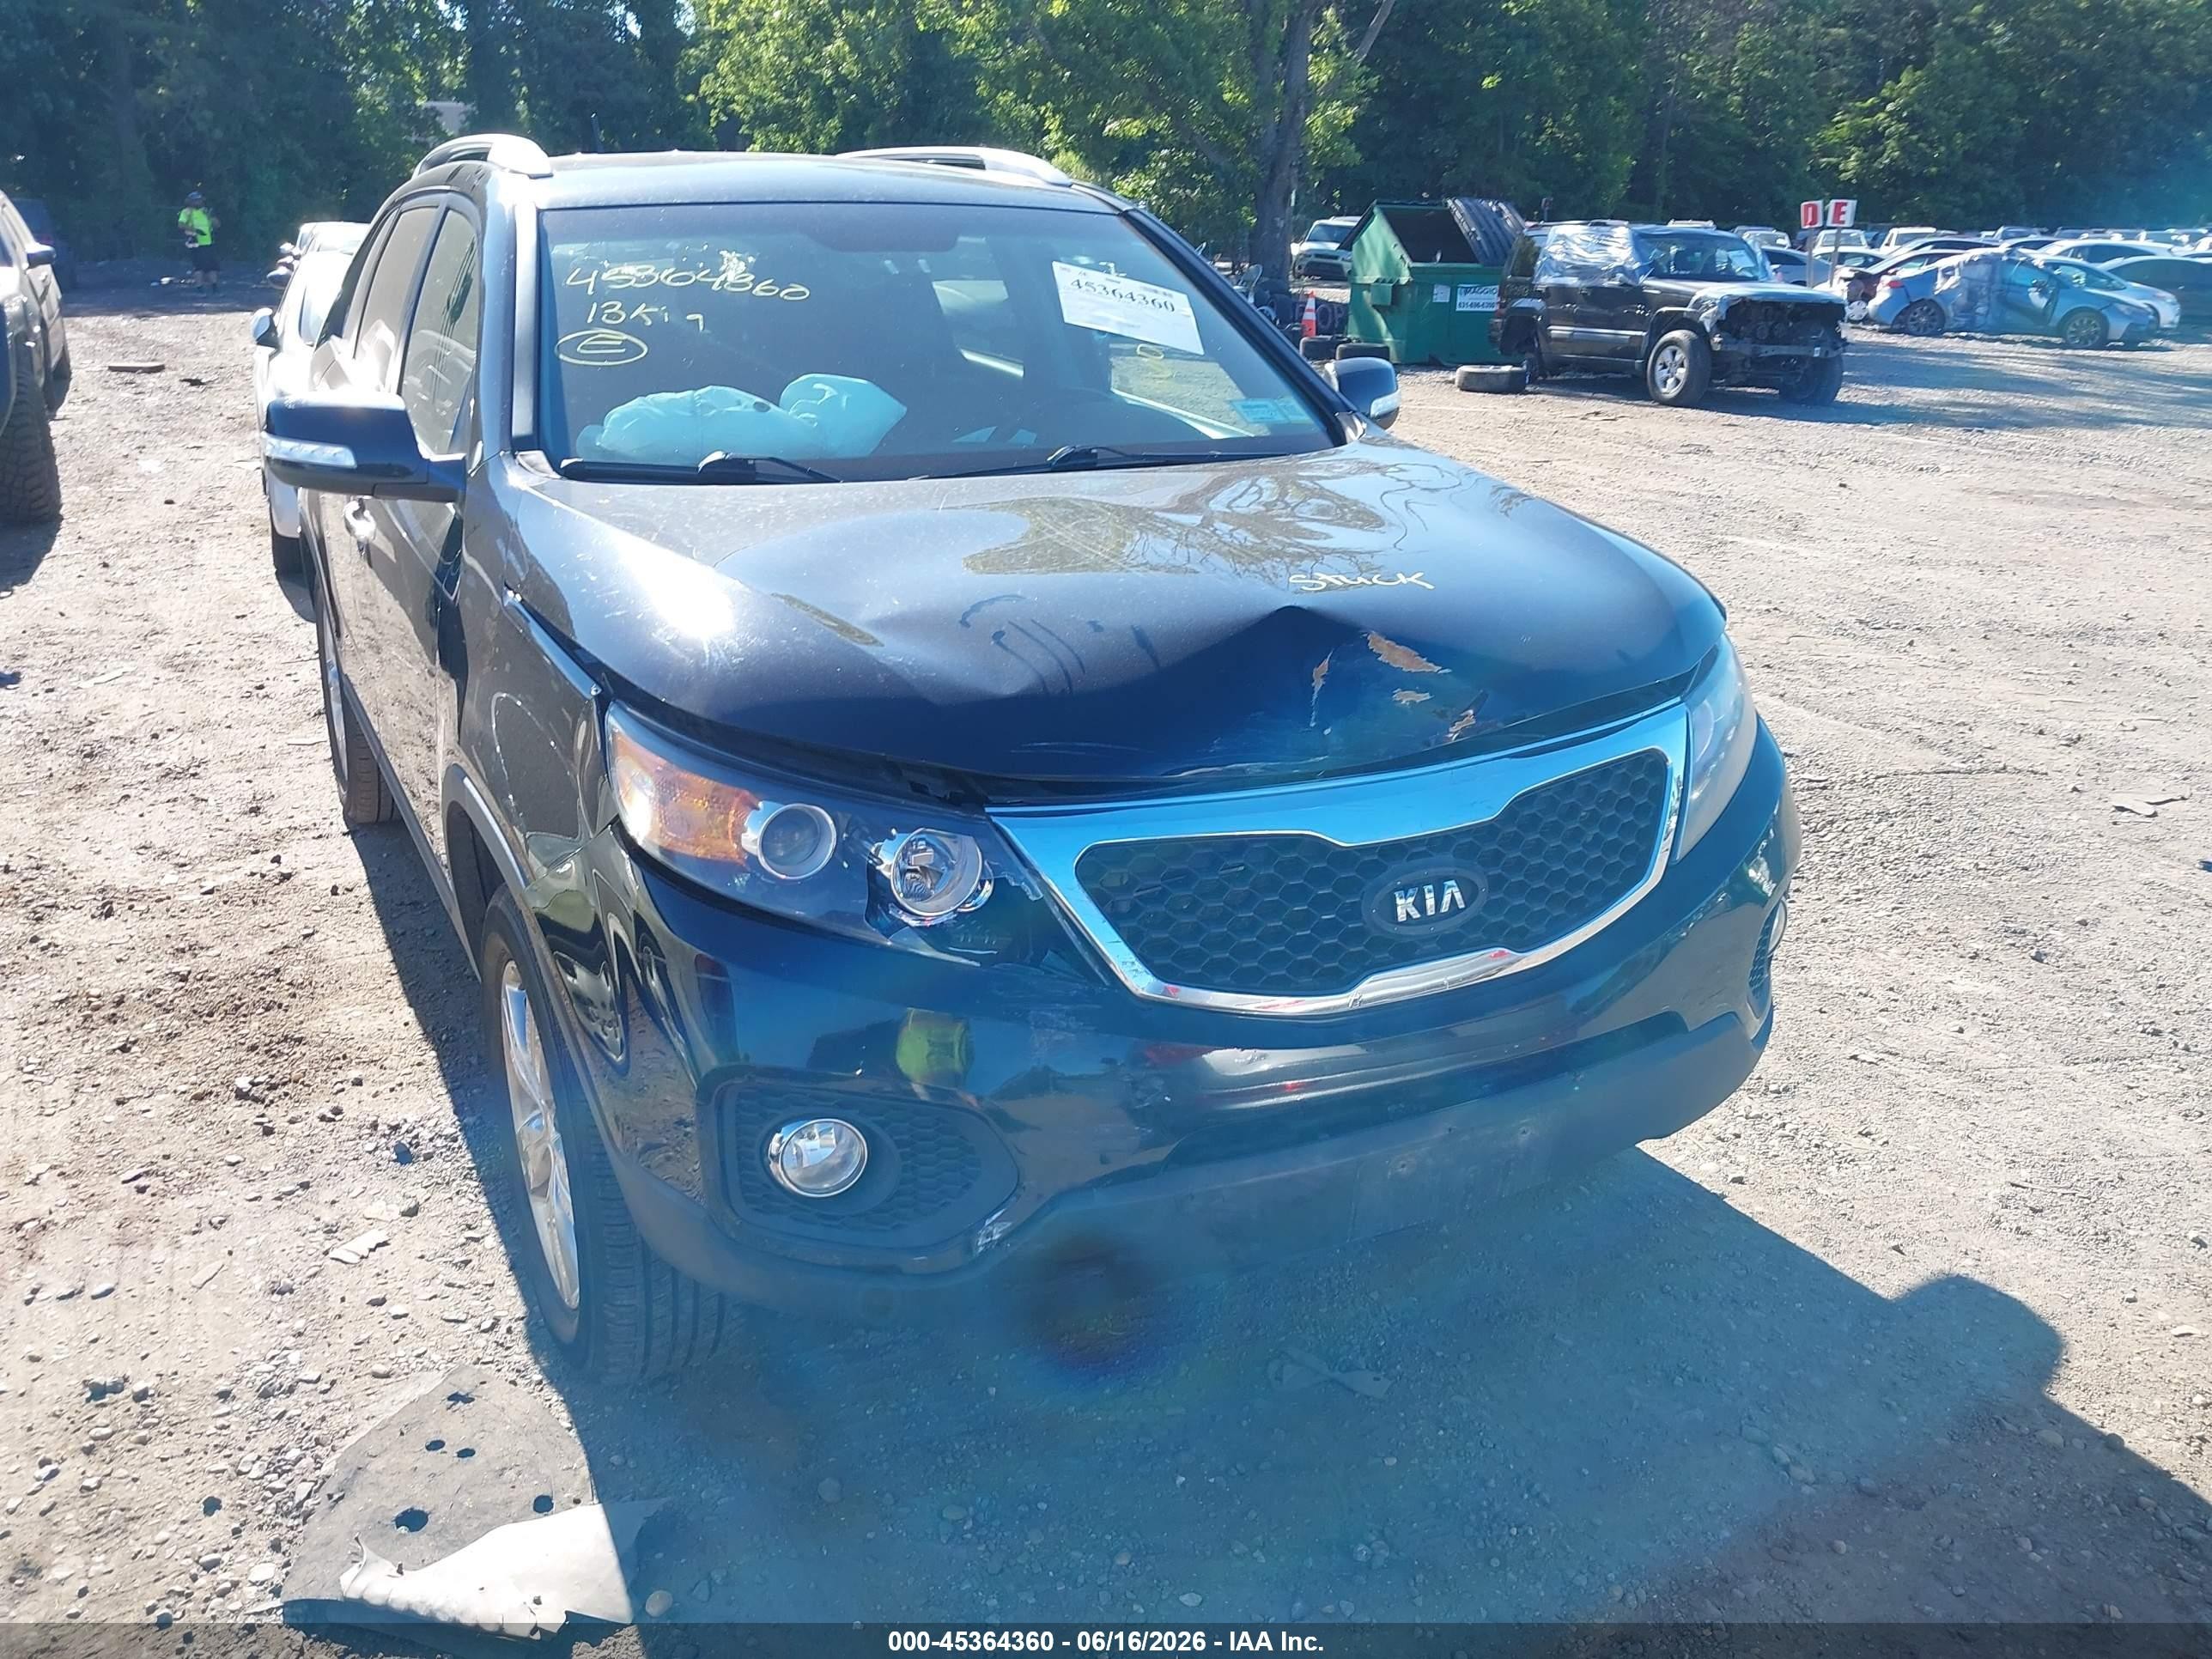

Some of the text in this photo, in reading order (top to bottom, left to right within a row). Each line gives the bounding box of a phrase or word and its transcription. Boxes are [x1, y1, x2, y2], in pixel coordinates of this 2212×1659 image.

[1831, 202, 1848, 225] E
[1070, 277, 1176, 313] 45364360
[1289, 572, 1435, 591] STUCK
[1394, 879, 1466, 922] KIA
